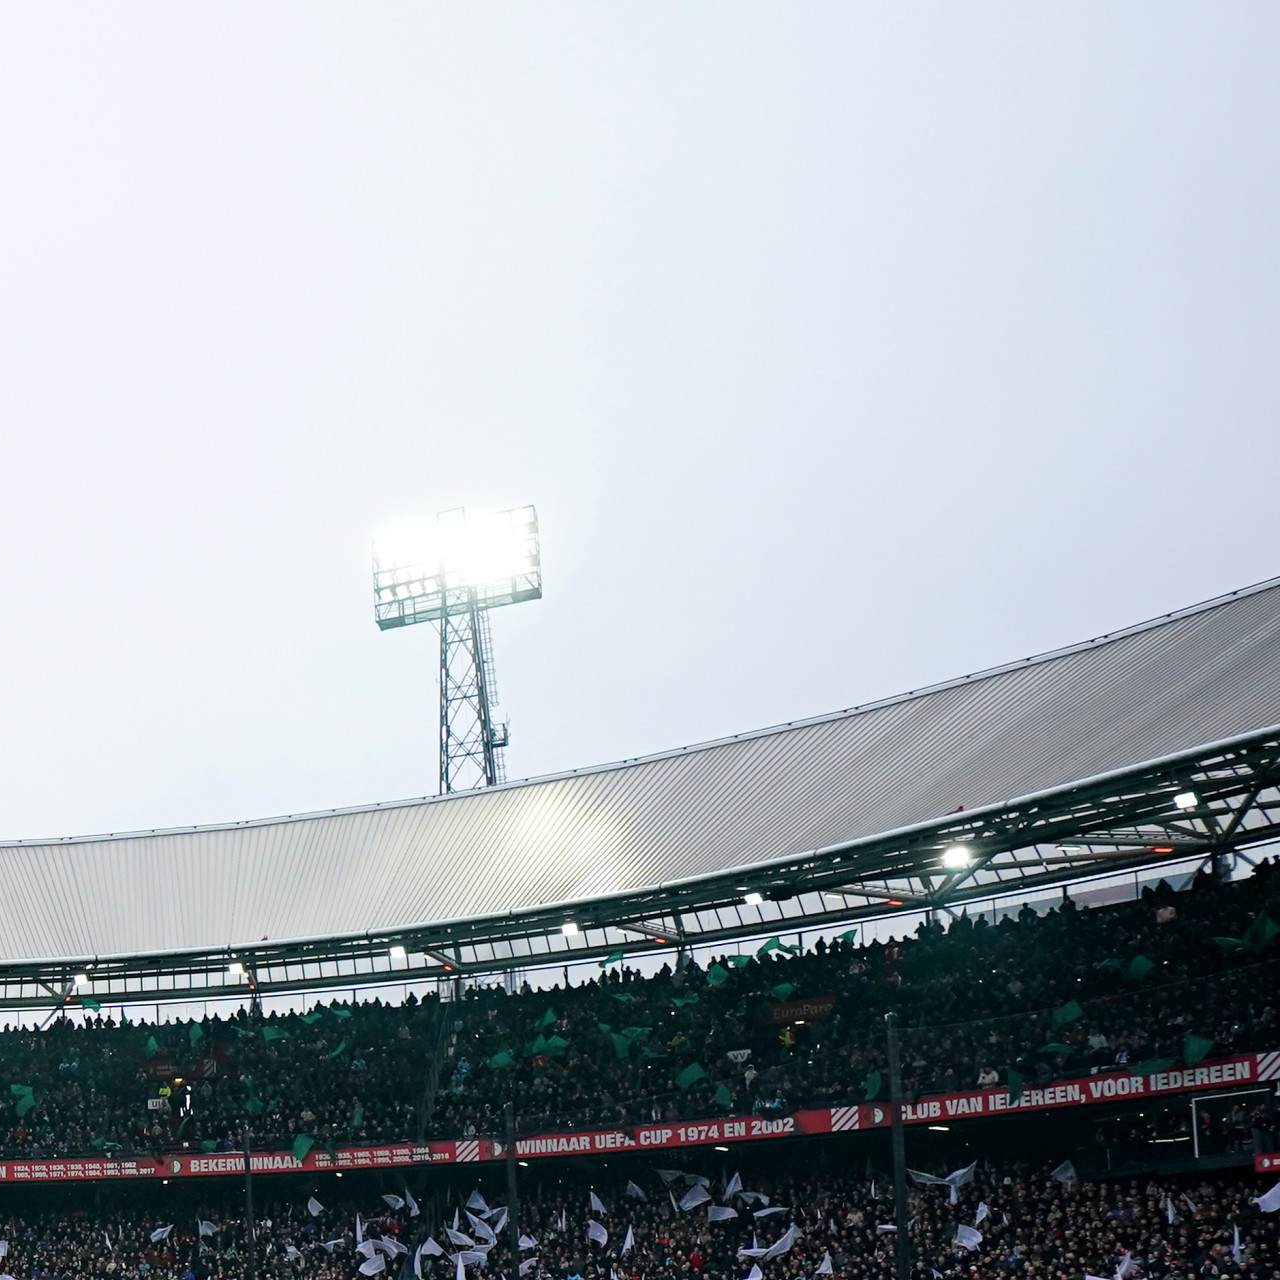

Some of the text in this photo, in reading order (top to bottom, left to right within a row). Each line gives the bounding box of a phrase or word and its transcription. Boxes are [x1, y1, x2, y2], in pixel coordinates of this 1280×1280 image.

[945, 1095, 983, 1115] VAN
[1088, 1076, 1144, 1098] VOOR
[1149, 1061, 1251, 1091] IEDEREEN
[515, 1117, 795, 1155] WINNAAR UEFA CUP 1974 EN 2002
